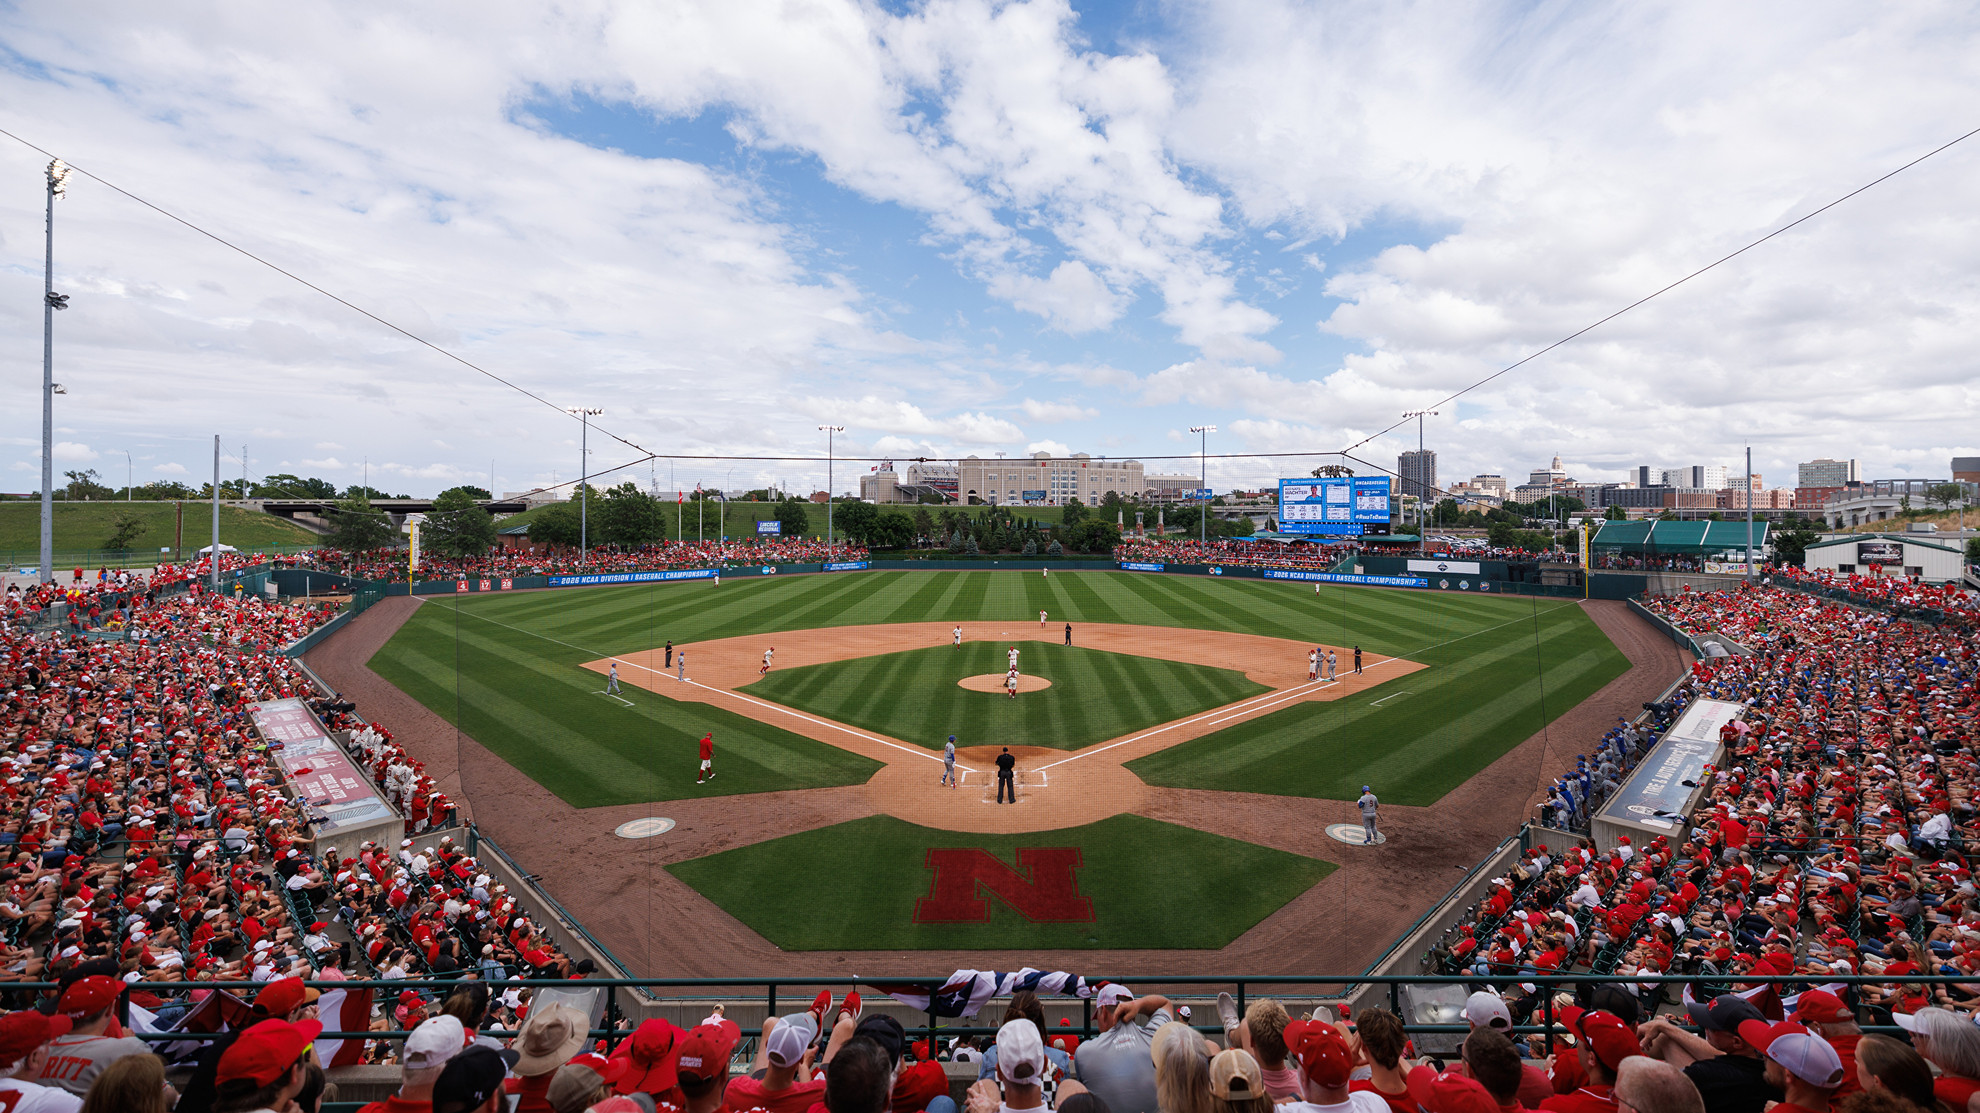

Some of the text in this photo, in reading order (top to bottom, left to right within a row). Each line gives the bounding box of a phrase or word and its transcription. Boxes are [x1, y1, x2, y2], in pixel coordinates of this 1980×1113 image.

[560, 577, 580, 585] 2026
[581, 575, 599, 584] NCAA
[600, 574, 629, 583] DIVISION
[634, 572, 665, 581] BASEBALL
[665, 570, 710, 579] CHAMPIONSHIP
[1305, 573, 1331, 581] DIVISION
[1336, 575, 1366, 583] BASEBALL
[1366, 576, 1416, 586] CHAMPIONSHIP
[1642, 782, 1665, 796] TIRE
[912, 847, 1096, 923] N
[40, 1056, 93, 1082] RITT
